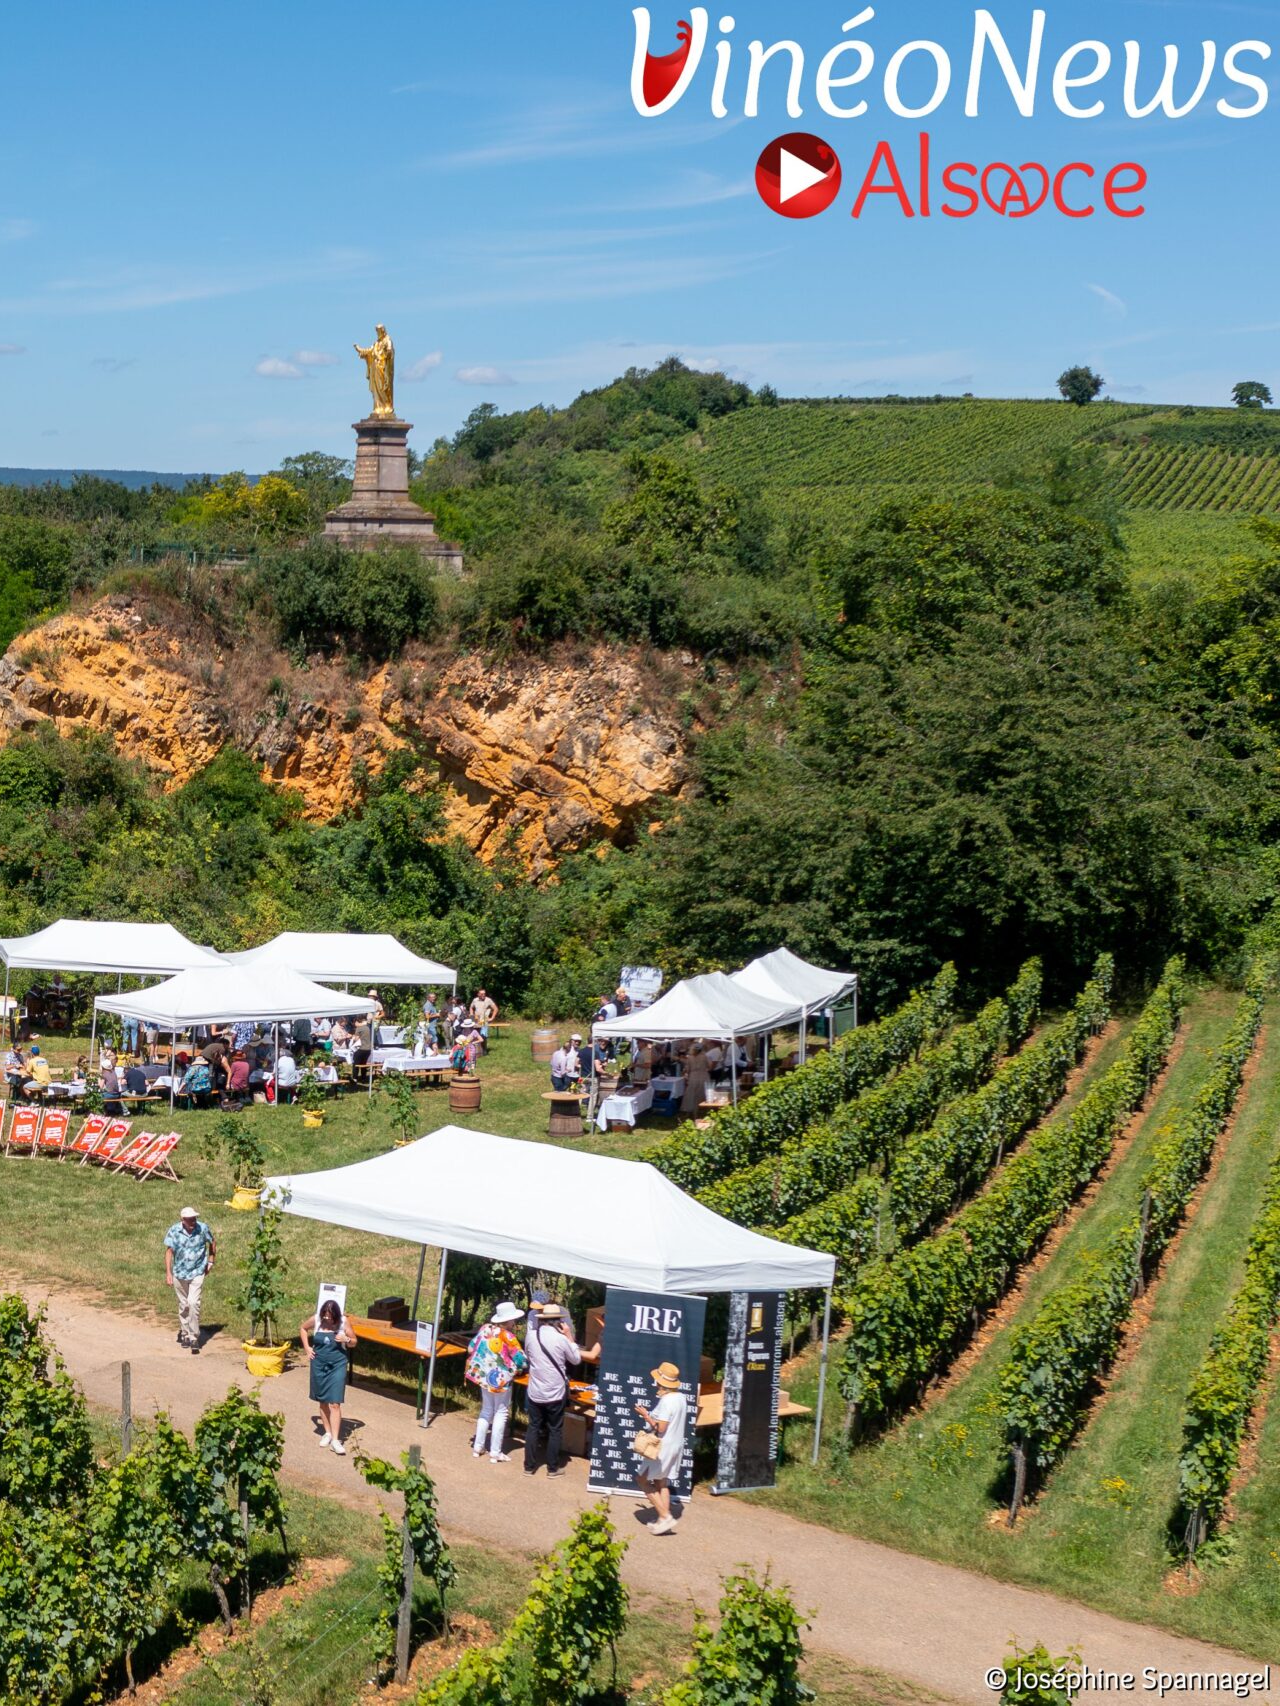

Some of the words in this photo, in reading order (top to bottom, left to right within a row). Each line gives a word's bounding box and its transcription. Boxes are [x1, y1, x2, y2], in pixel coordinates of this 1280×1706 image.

[625, 1304, 682, 1335] JRE
[603, 1372, 619, 1381] JRE
[627, 1376, 643, 1384] JRE
[607, 1384, 622, 1392] JRE
[631, 1387, 647, 1395] JRE
[610, 1396, 627, 1404] JRE
[615, 1407, 631, 1416] JRE
[594, 1416, 610, 1424] JRE
[619, 1419, 635, 1427] JRE
[598, 1427, 614, 1435] JRE
[602, 1438, 618, 1447] JRE
[606, 1450, 622, 1458] JRE
[611, 1462, 627, 1470] JRE
[617, 1473, 632, 1481] JRE
